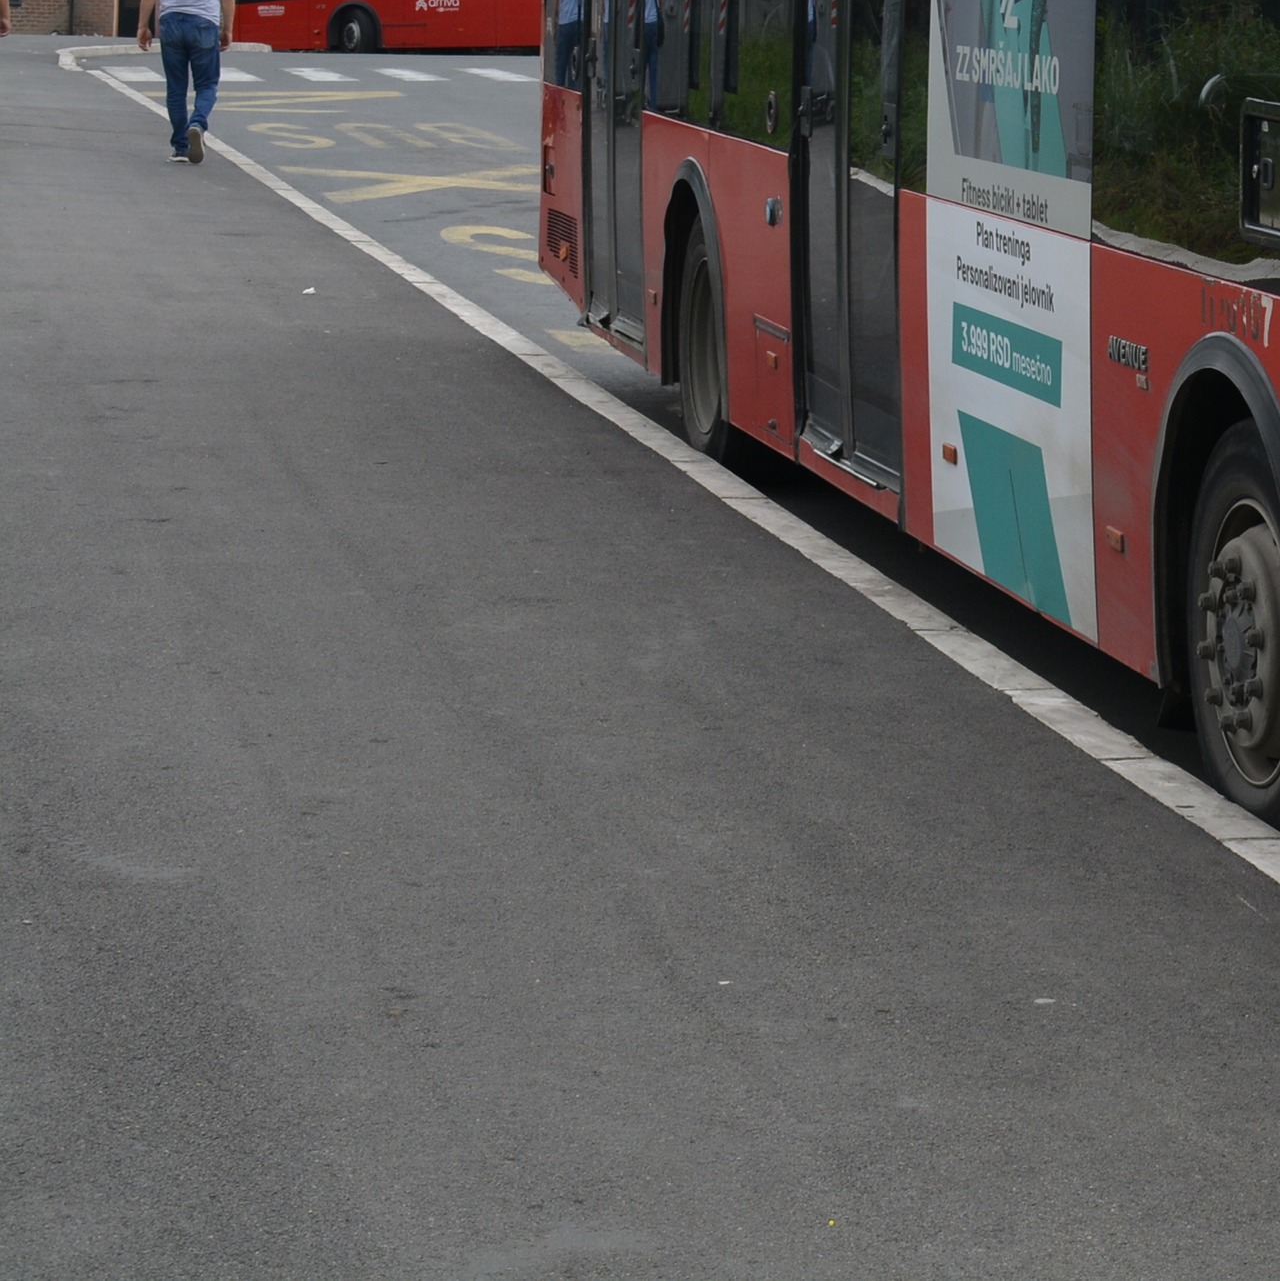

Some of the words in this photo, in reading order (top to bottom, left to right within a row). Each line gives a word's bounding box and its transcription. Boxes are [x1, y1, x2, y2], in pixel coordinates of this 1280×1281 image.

[971, 41, 1022, 90] SMRŠAJ
[1023, 53, 1060, 96] LAKO
[961, 177, 991, 210] Fitness
[992, 183, 1015, 216] bicikl
[1022, 192, 1049, 224] tablet
[976, 221, 995, 251] Plan
[995, 230, 1031, 266] treninga
[956, 255, 1020, 301] Personalizovani
[1020, 276, 1055, 313] jelovnik
[961, 321, 989, 361] 3.999
[989, 331, 1011, 369] RSD
[1012, 350, 1052, 387] mesečno
[1108, 334, 1149, 373] AVENUE
